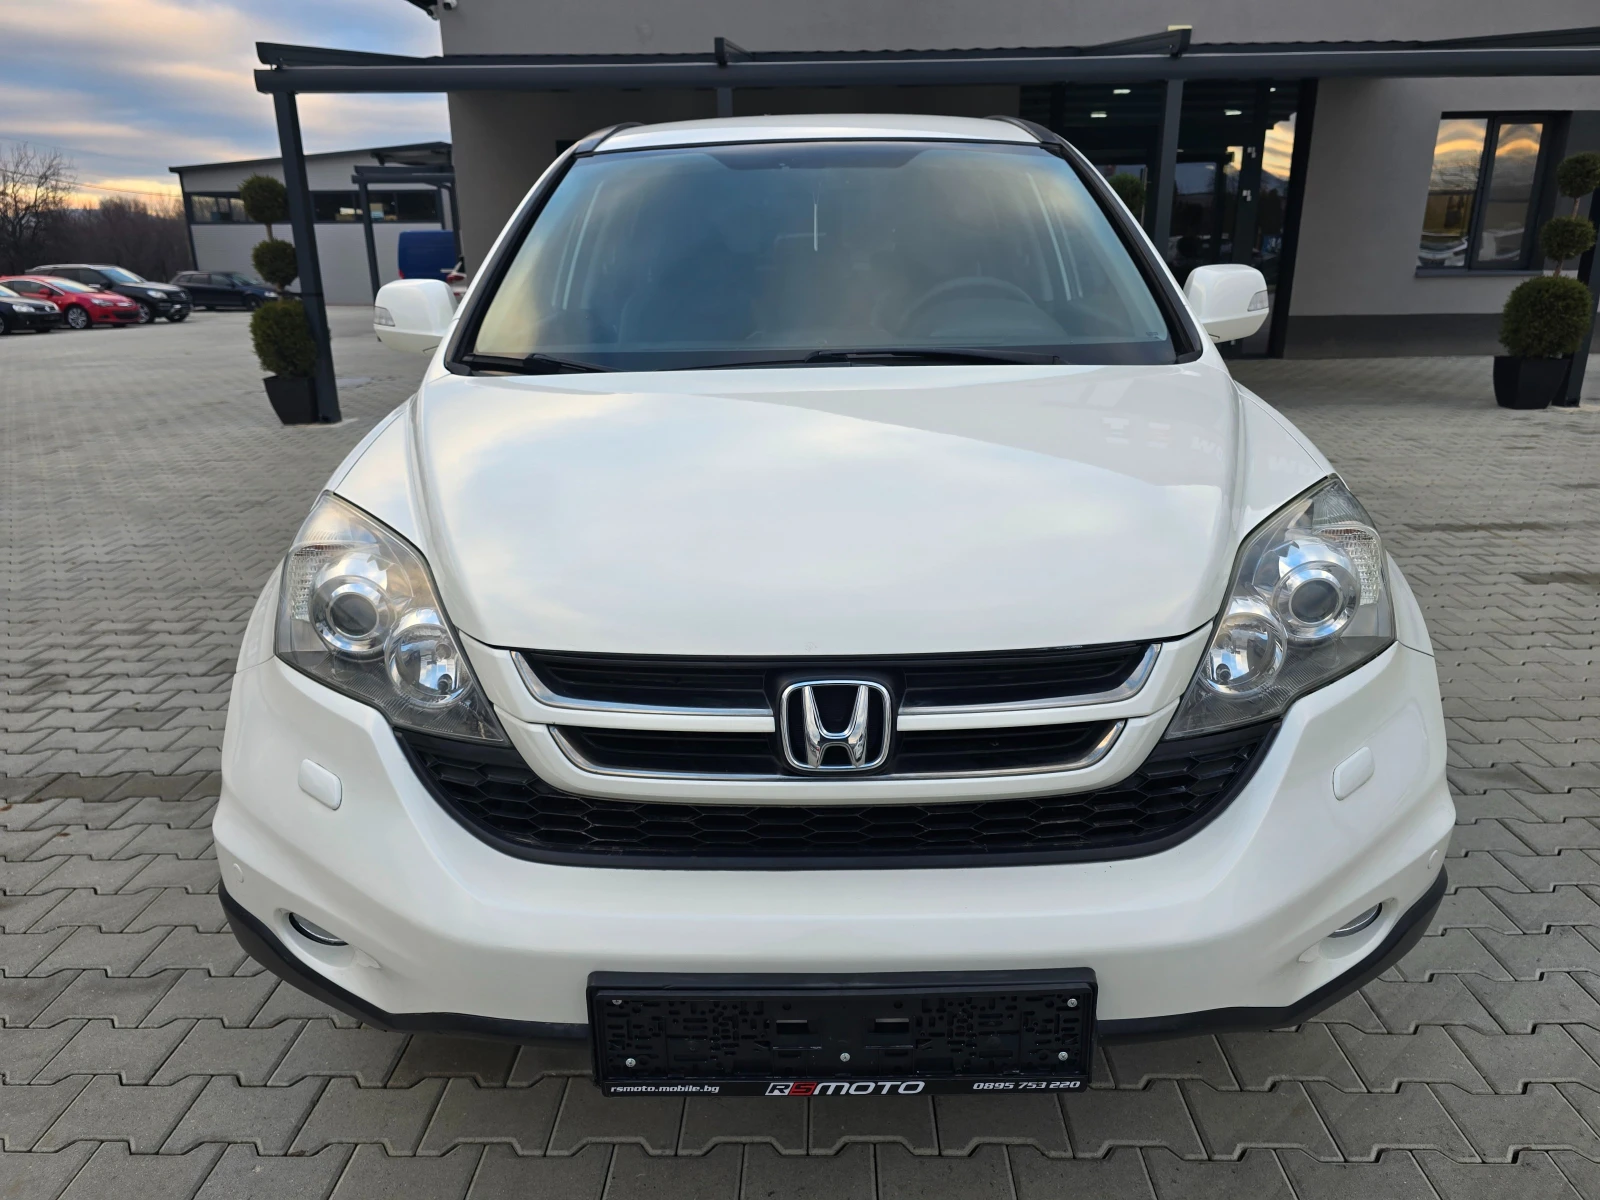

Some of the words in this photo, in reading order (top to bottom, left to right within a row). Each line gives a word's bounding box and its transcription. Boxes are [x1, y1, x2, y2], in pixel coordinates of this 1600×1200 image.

[610, 1084, 720, 1094] rsmoto.mobile.bg
[764, 1081, 926, 1096] RSMOTO
[972, 1082, 1016, 1090] 0895
[1018, 1081, 1048, 1089] 753
[1049, 1080, 1081, 1089] 220
